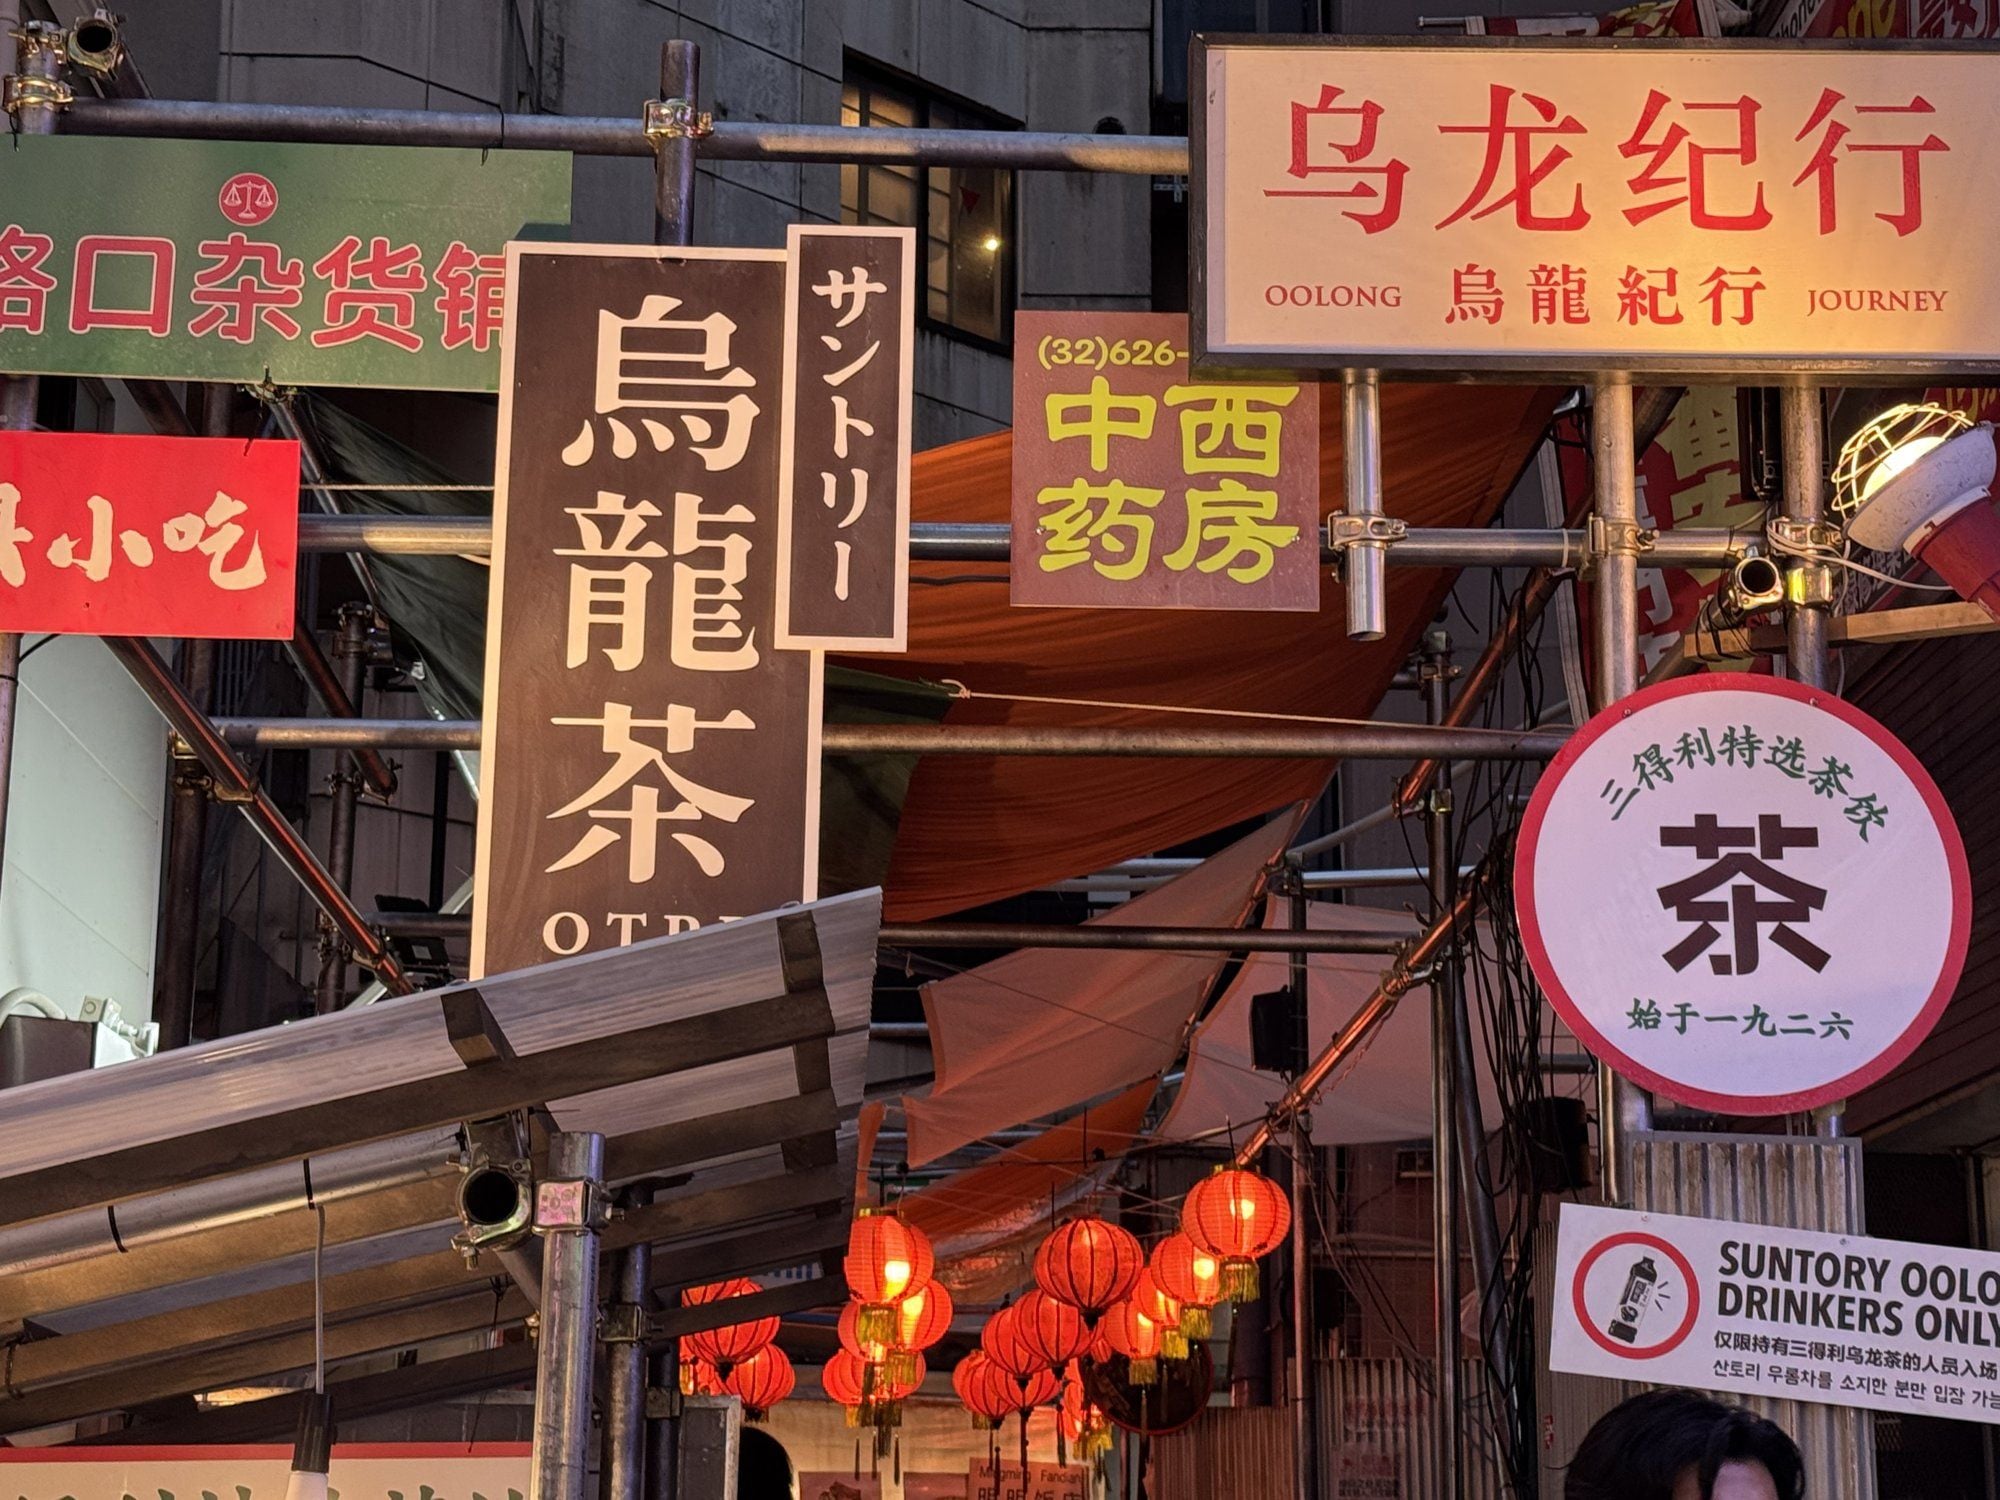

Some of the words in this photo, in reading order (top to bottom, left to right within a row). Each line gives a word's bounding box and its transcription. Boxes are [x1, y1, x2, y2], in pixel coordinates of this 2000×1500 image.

[1263, 83, 1950, 236] 乌龙纪行
[1264, 284, 1402, 309] OOLONG
[1445, 263, 1767, 327] 烏龍紀行
[1806, 288, 1949, 316] JOURNEY
[812, 266, 887, 601] サントリー
[1045, 375, 1300, 478] 中西
[1037, 477, 1300, 584] 药房
[545, 295, 760, 884] 烏龍茶
[1600, 724, 1888, 842] 三得利特选茶饮
[1656, 814, 1832, 975] 茶
[1626, 997, 1854, 1040] 始于一九二六
[1719, 1240, 1891, 1293] SUNTORY
[1901, 1262, 2000, 1307] OOLO
[1718, 1282, 1903, 1337] DRINKERS
[1713, 1359, 1760, 1382] 산토리
[1840, 1373, 1887, 1394] 소지한
[1895, 1380, 1927, 1400] 분만
[1934, 1385, 1965, 1405] 입장
[1714, 1330, 1998, 1380] 仅限持有三得利乌龙茶的人员入场
